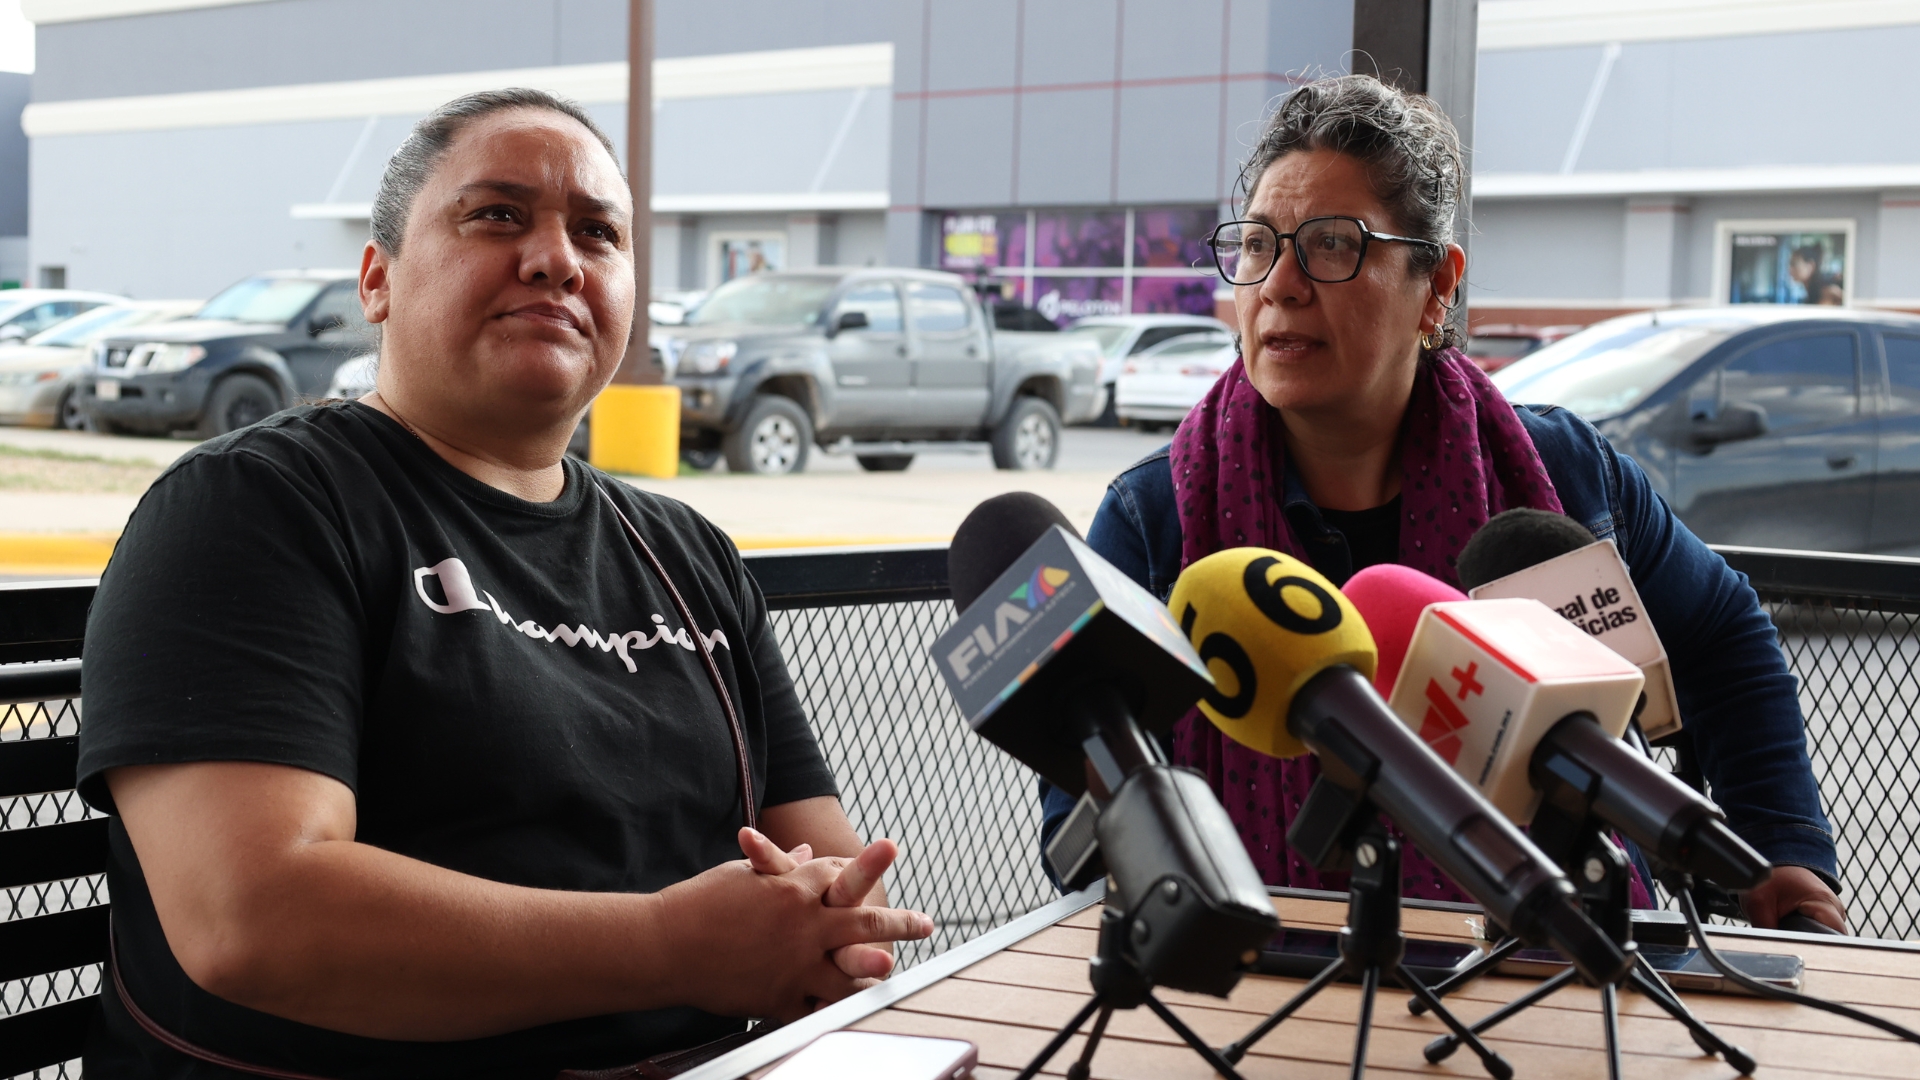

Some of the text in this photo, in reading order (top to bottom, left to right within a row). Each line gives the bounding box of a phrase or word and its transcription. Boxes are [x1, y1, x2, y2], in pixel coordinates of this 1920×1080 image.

[413, 557, 730, 673] Champion
[1243, 556, 1342, 635] 6
[1574, 605, 1637, 636] icias
[1591, 586, 1621, 610] de
[946, 601, 1031, 682] FIA
